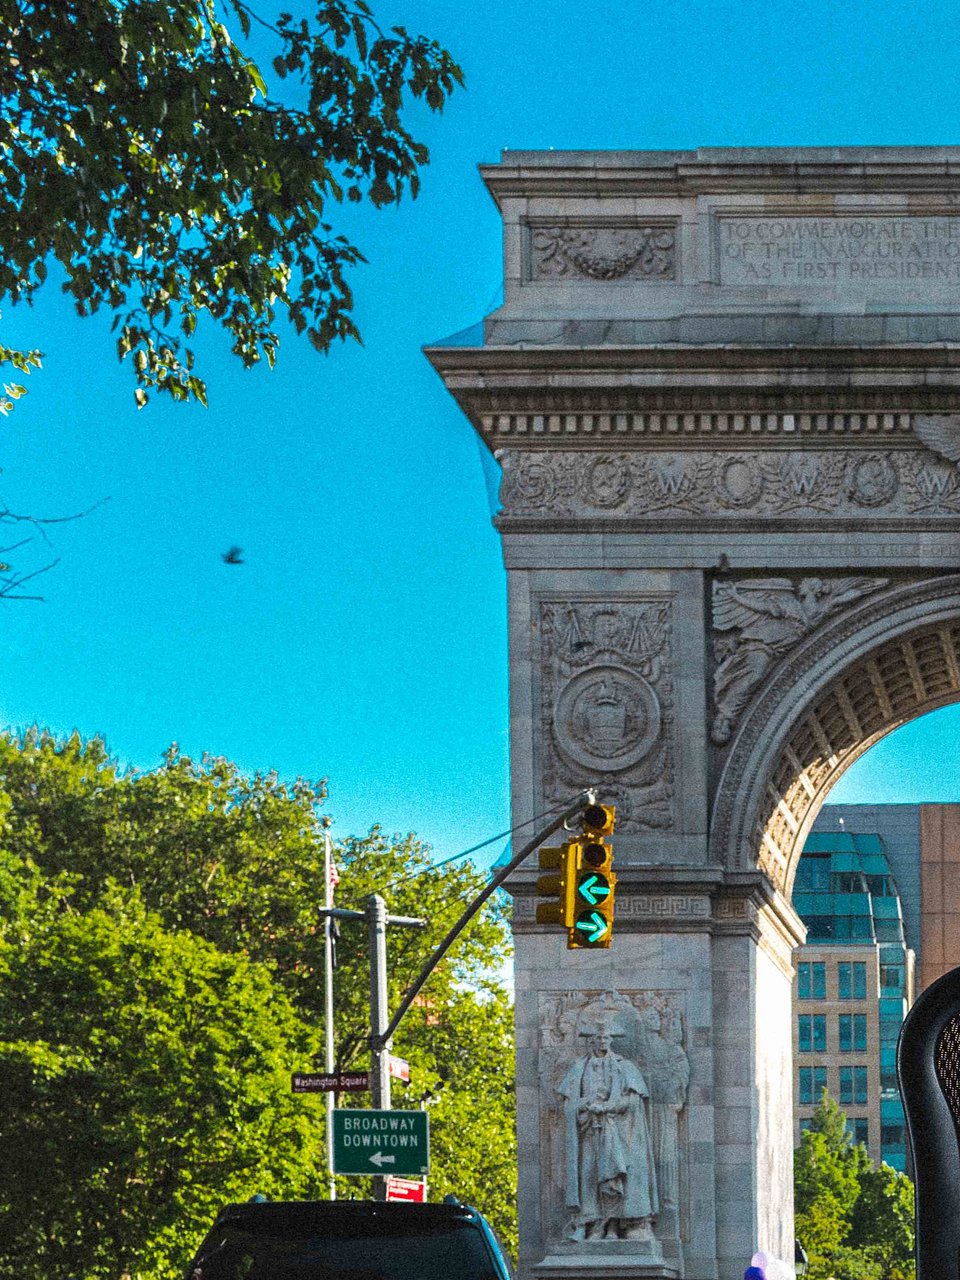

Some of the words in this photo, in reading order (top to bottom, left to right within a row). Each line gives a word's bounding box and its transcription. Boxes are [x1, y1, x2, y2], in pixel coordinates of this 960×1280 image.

[724, 222, 750, 239] TO
[756, 221, 913, 239] COMMEMORATE
[922, 221, 960, 239] THE
[725, 242, 756, 259] OF
[764, 242, 804, 259] THE
[744, 262, 772, 279] AS
[782, 262, 841, 279] FIRST
[294, 1076, 338, 1089] Washington
[340, 1076, 367, 1087] Square
[344, 1117, 415, 1130] BROADWAY
[343, 1134, 418, 1147] DOWNTOWN
